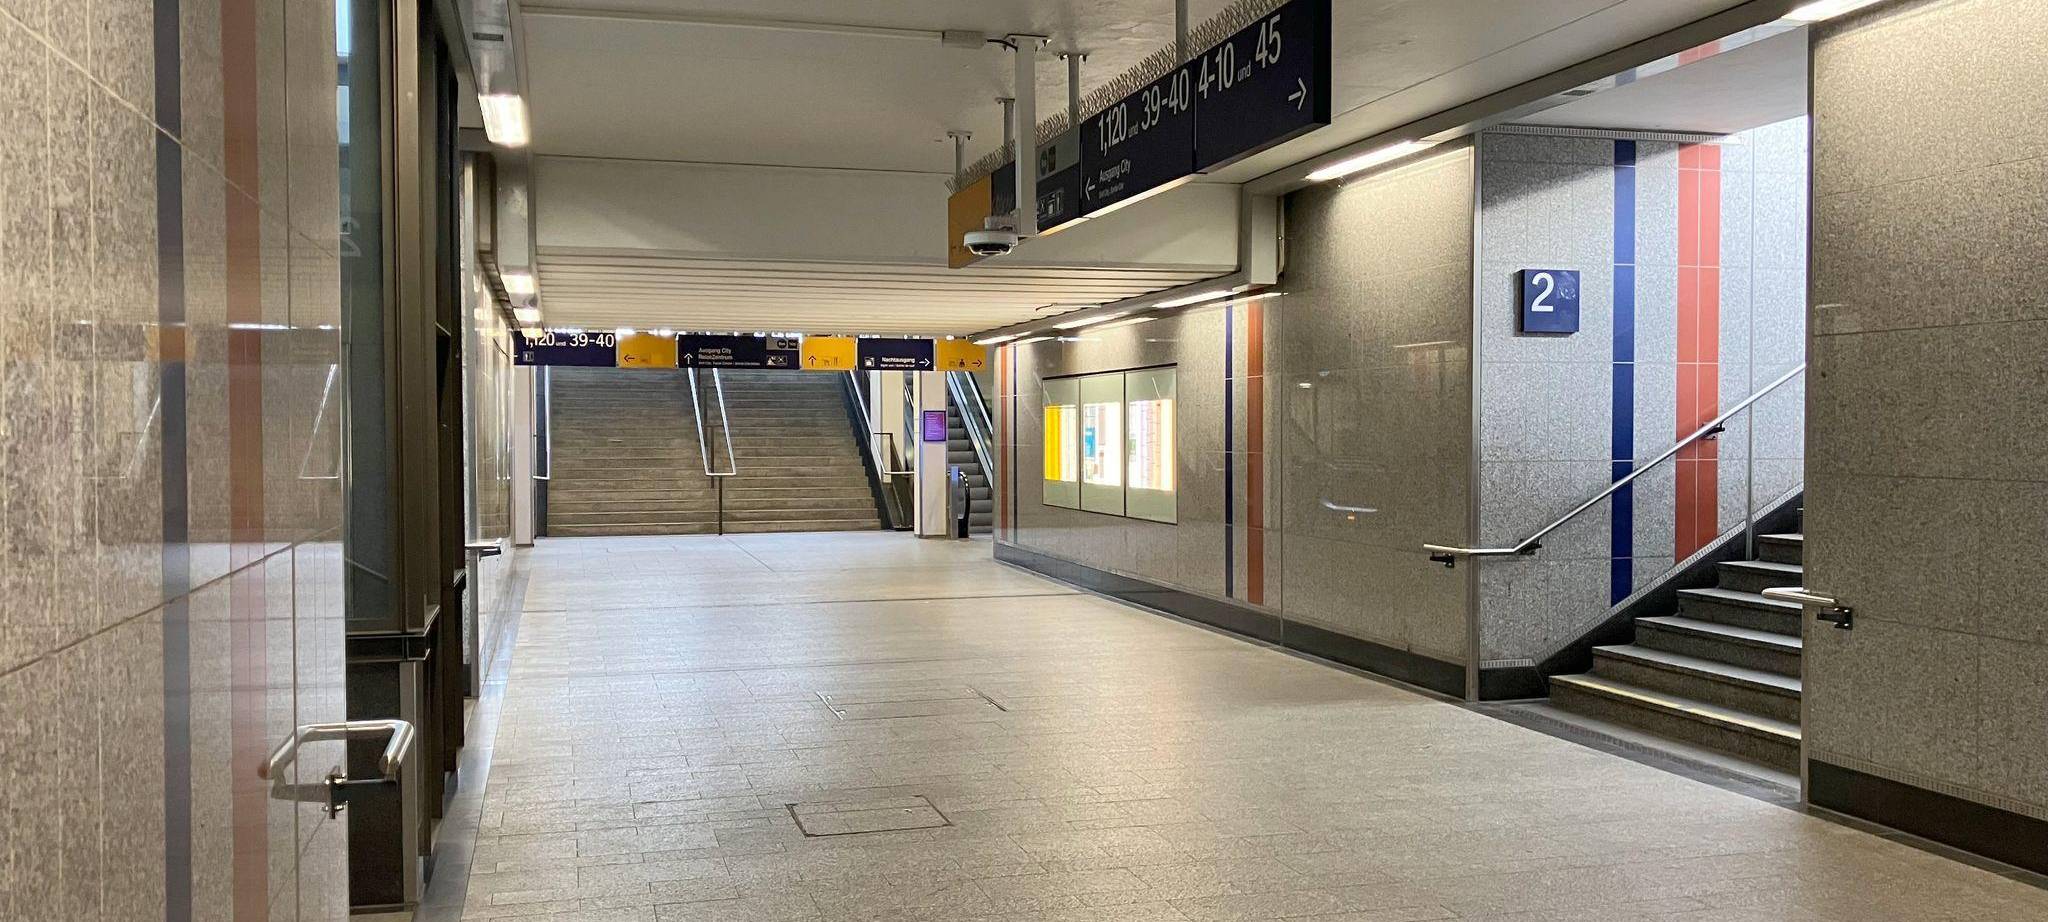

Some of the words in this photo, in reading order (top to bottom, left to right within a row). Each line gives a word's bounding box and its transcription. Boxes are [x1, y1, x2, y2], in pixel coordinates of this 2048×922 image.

[1198, 42, 1235, 99] 4-10
[1238, 60, 1252, 83] und
[1255, 14, 1282, 69] 45
[1098, 103, 1128, 157] 1,120
[1141, 68, 1190, 131] 39-40
[1099, 164, 1121, 184] Ausgang
[1120, 159, 1131, 175] City
[1531, 272, 1554, 312] 2
[569, 333, 615, 348] 39-40
